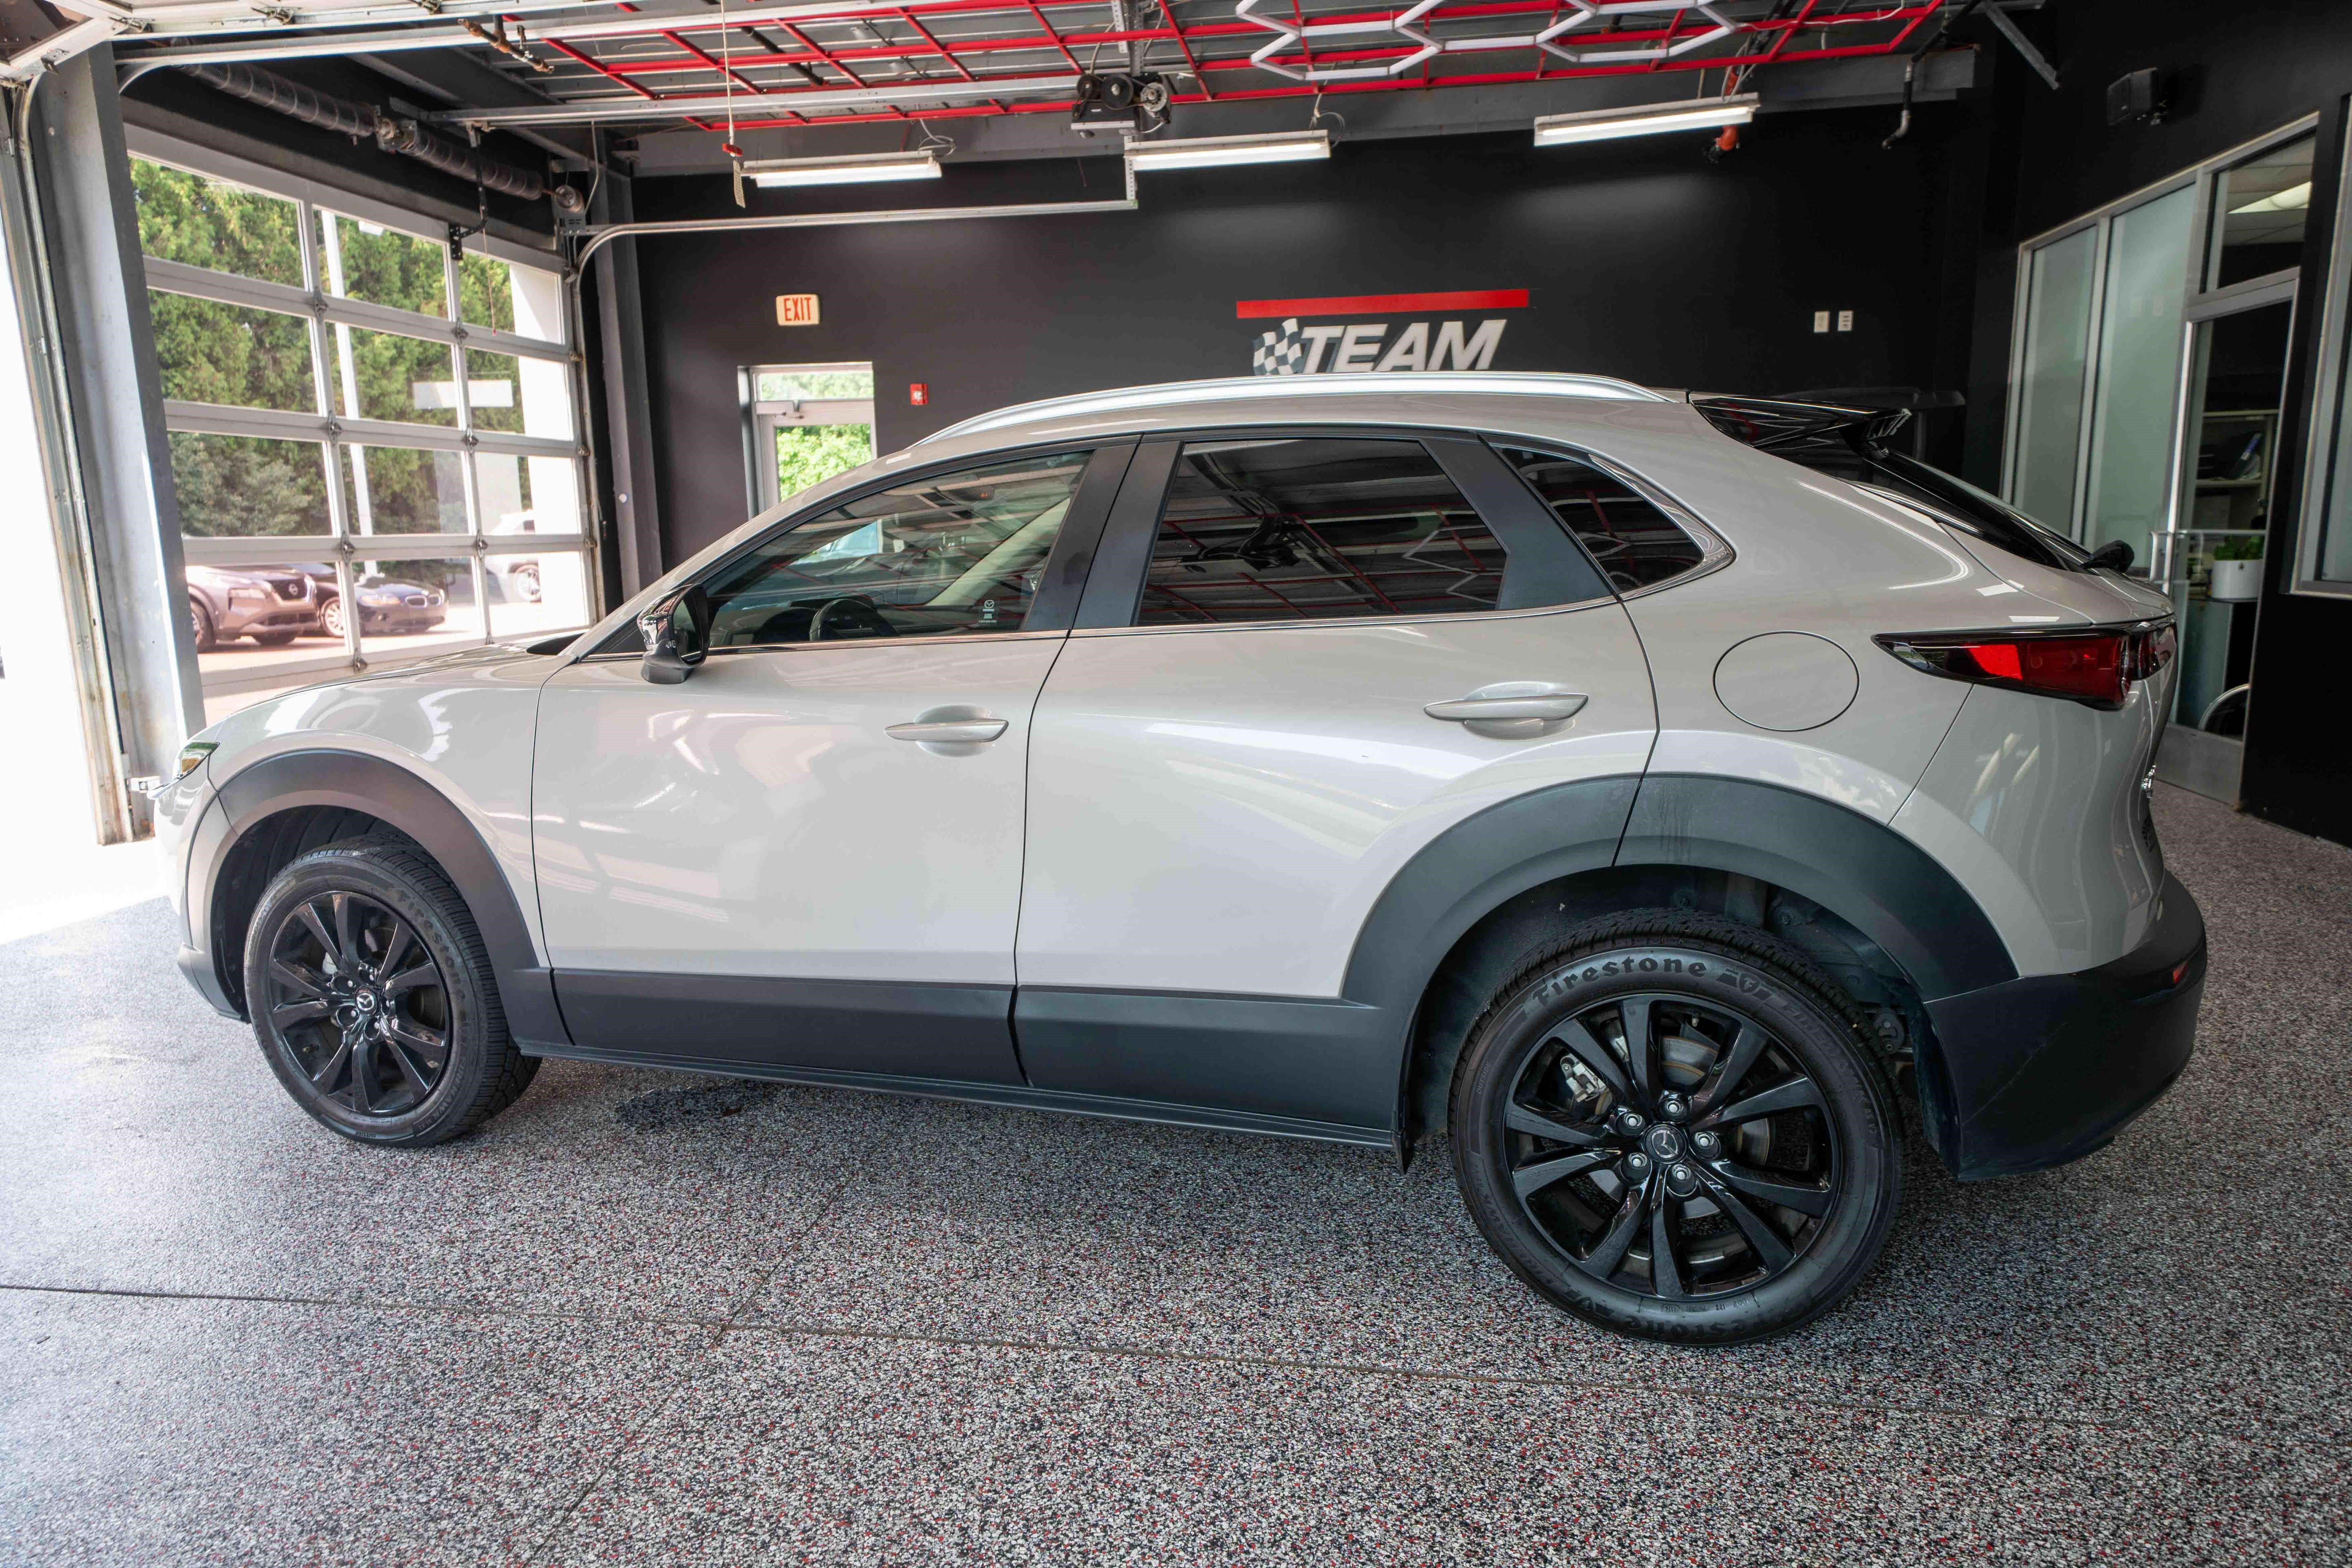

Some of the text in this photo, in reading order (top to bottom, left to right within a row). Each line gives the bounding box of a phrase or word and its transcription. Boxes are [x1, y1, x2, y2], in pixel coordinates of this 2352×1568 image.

[784, 297, 811, 321] EXIT
[1301, 319, 1507, 373] TEAM
[1532, 956, 1707, 1007] Firestone
